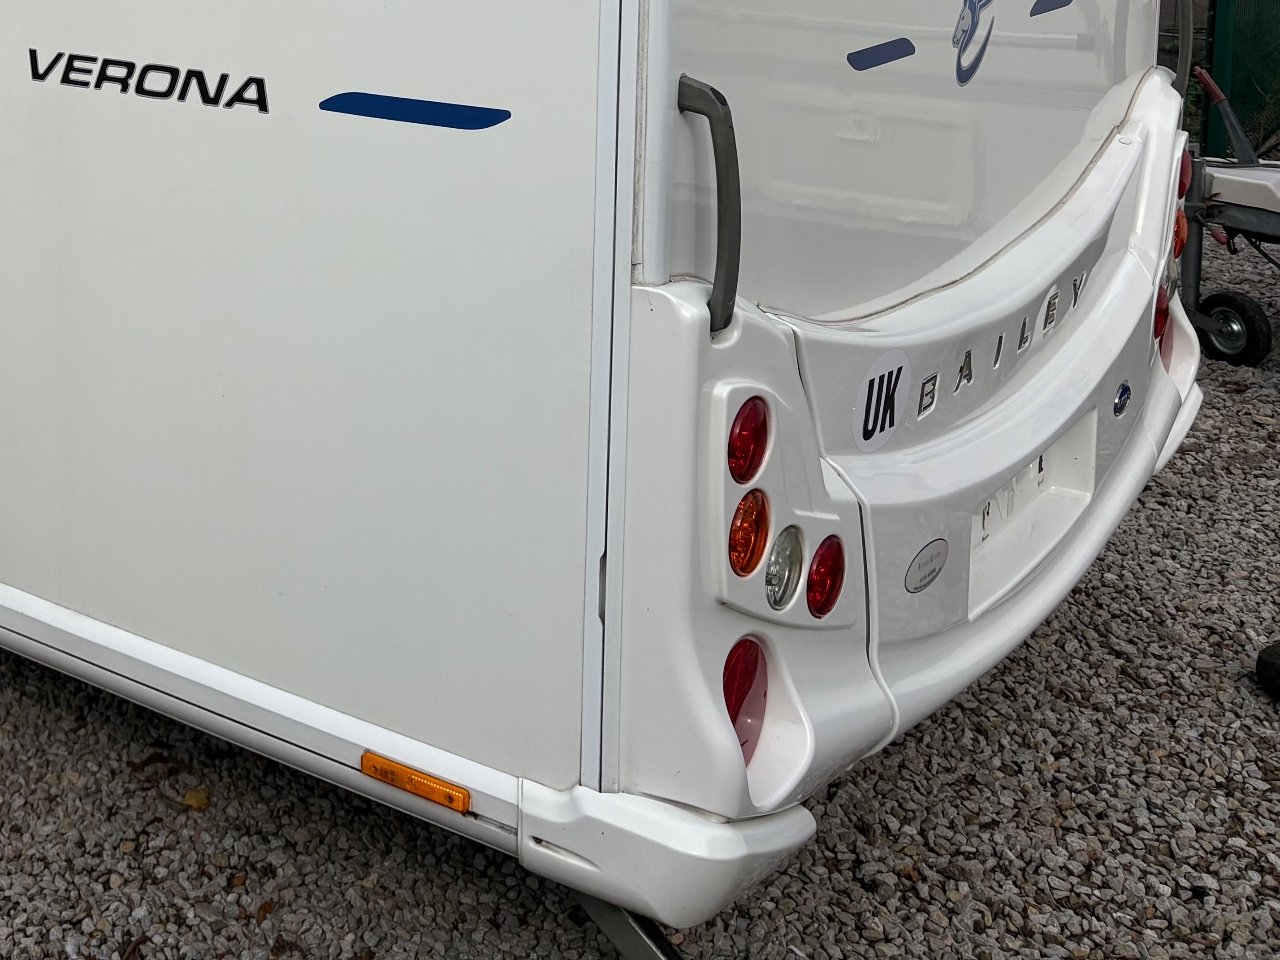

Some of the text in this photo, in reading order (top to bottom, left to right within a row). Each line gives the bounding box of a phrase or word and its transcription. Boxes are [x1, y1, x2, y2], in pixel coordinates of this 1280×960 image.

[28, 47, 270, 115] VERONA
[917, 271, 1087, 422] BAILEY
[862, 365, 904, 442] UK
